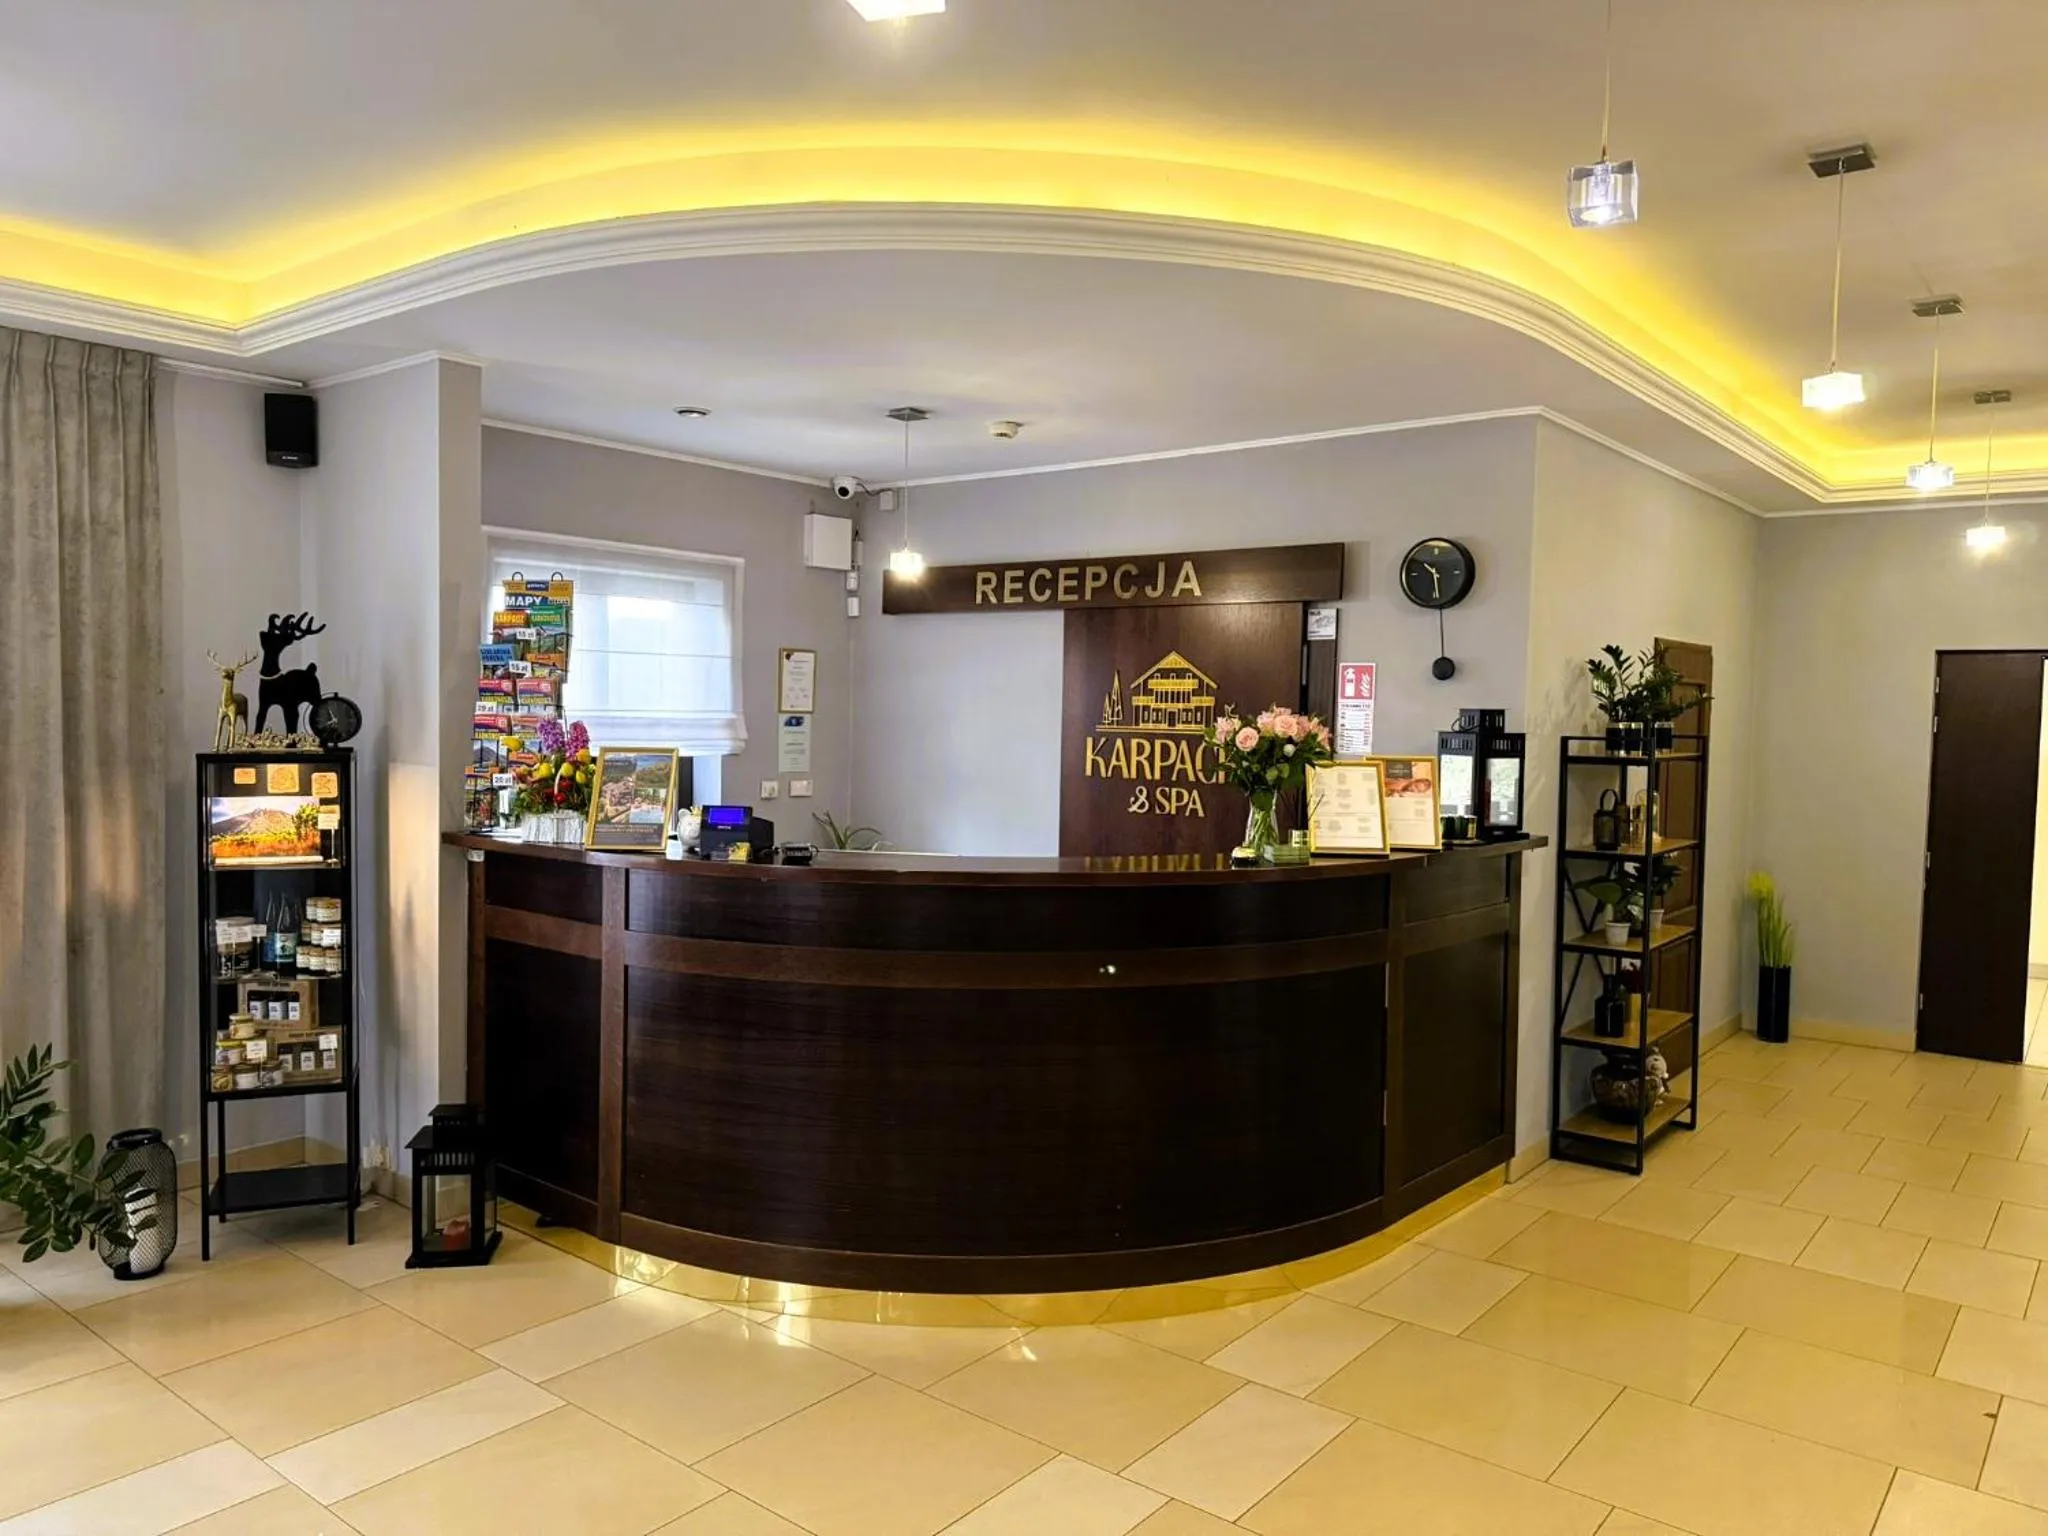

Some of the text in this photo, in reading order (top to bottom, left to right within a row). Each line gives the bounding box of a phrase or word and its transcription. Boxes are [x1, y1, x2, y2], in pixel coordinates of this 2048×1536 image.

[975, 560, 1202, 604] RECEPCJA
[505, 596, 541, 606] MAPY
[1127, 785, 1205, 817] & SPA
